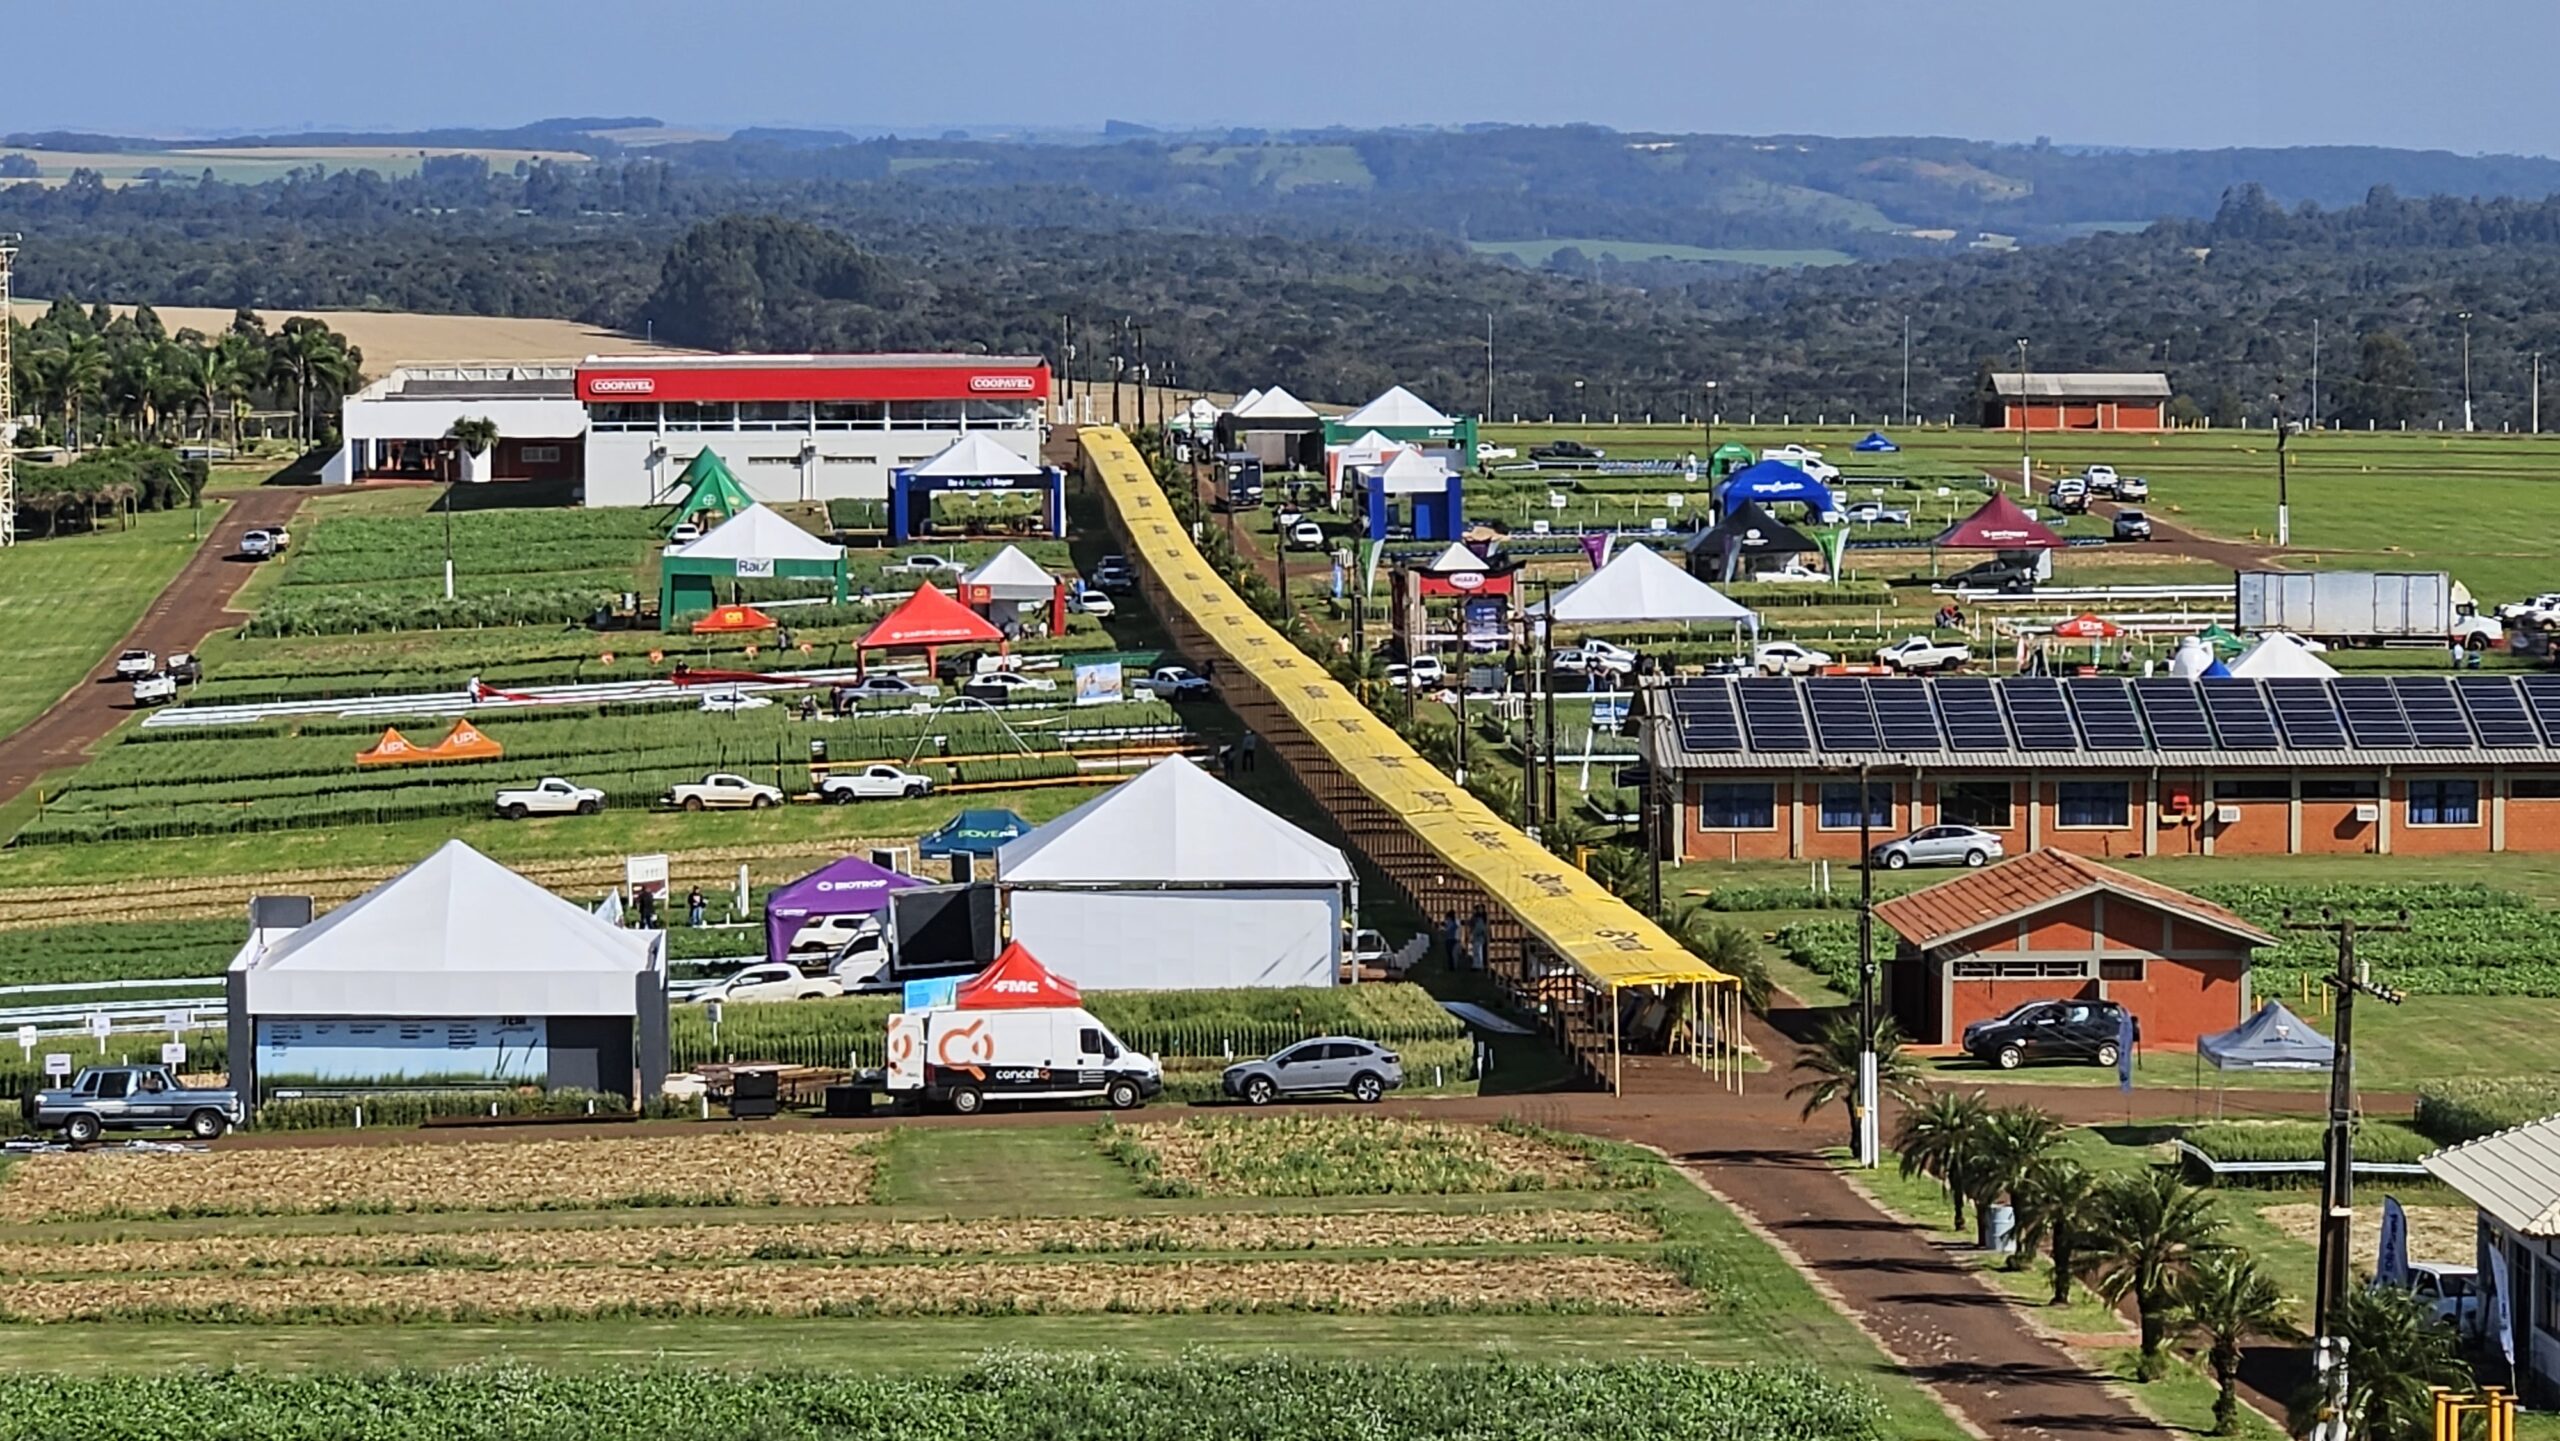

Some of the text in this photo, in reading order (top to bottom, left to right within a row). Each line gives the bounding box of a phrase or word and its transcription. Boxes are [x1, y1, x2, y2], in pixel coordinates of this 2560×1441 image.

[594, 380, 653, 391] COOPAVEL
[974, 379, 1033, 389] COOPAVEL
[452, 730, 481, 745] UPL
[379, 741, 408, 754] UPL
[834, 879, 888, 891] BIOTROP
[998, 980, 1039, 993] FMC
